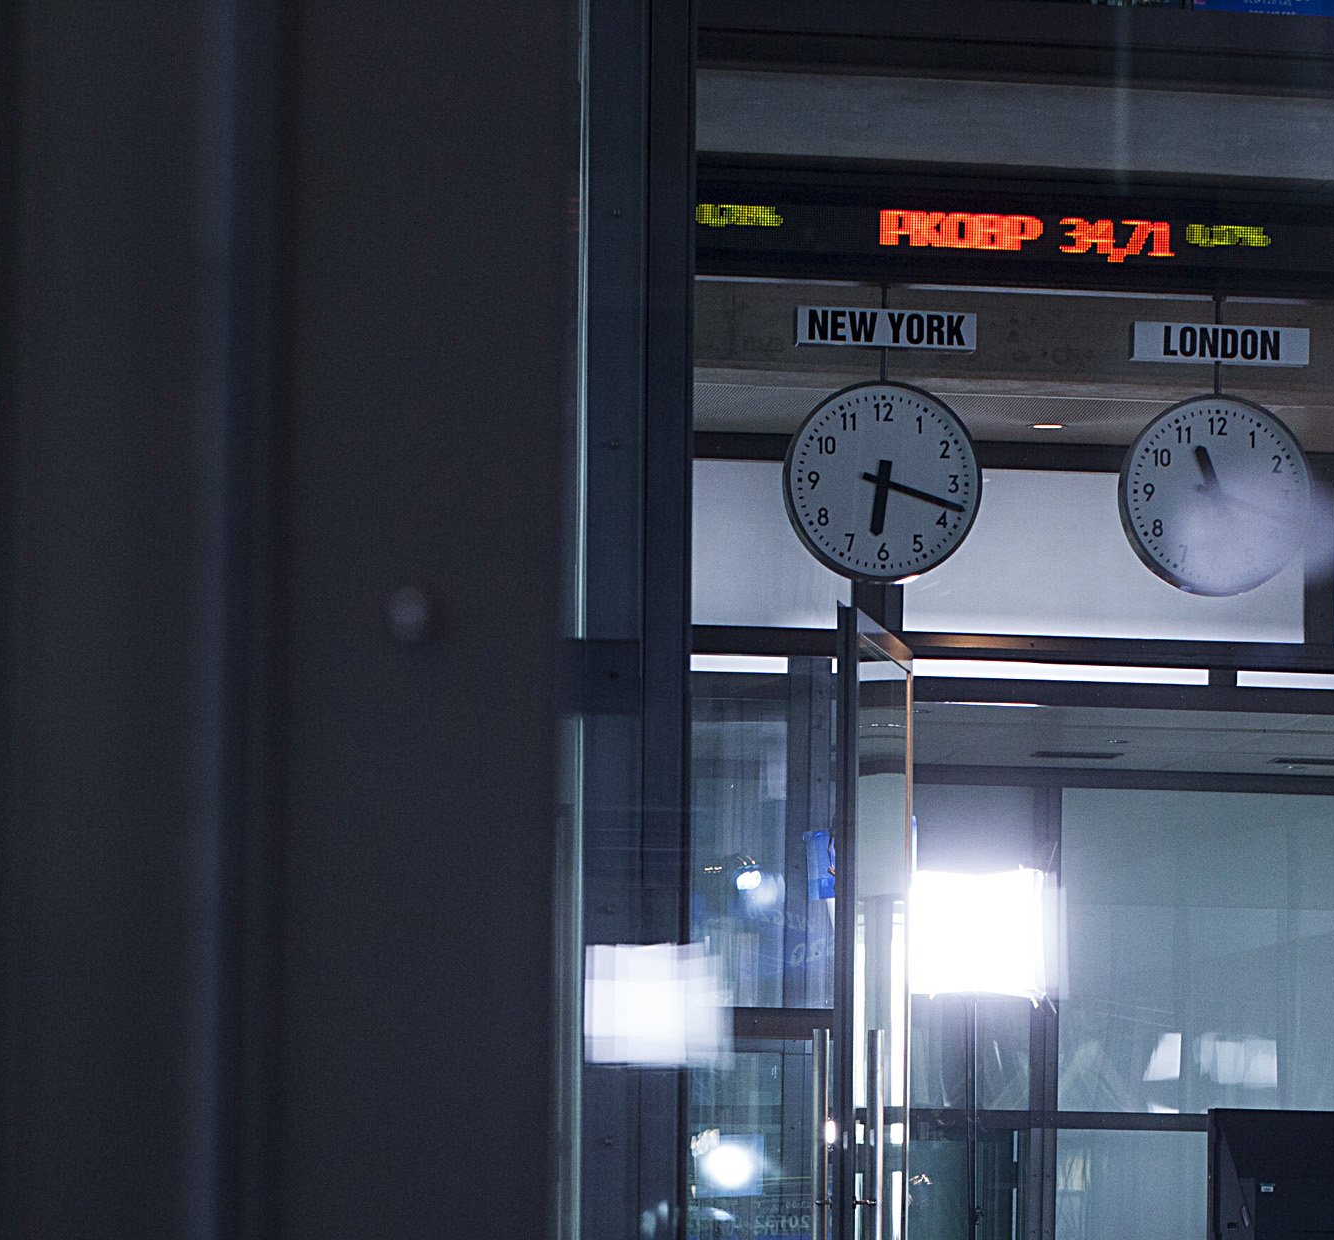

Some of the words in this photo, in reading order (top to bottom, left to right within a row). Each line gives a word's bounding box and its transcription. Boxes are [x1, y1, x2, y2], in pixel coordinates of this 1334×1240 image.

[879, 209, 1043, 250] PKOBP
[1058, 217, 1175, 262] 34,71
[807, 308, 877, 343] NEW
[887, 312, 966, 346] YORK
[1163, 325, 1281, 361] LONDON
[840, 412, 858, 432] 11
[873, 403, 895, 423] 12
[915, 416, 924, 435] 1
[1175, 425, 1192, 444] 11
[1208, 416, 1228, 436] 12
[816, 435, 837, 455] 10
[939, 439, 950, 459] 2
[1249, 430, 1256, 449] 1
[1152, 448, 1172, 468] 10
[1271, 454, 1282, 473] 2
[807, 470, 821, 490] 9
[948, 474, 960, 494] 3
[1142, 482, 1156, 502] 9
[817, 507, 830, 527] 8
[935, 511, 948, 529] 4
[1151, 518, 1164, 538] 8
[844, 533, 856, 553] 7
[876, 542, 890, 562] 6
[912, 533, 924, 553] 5
